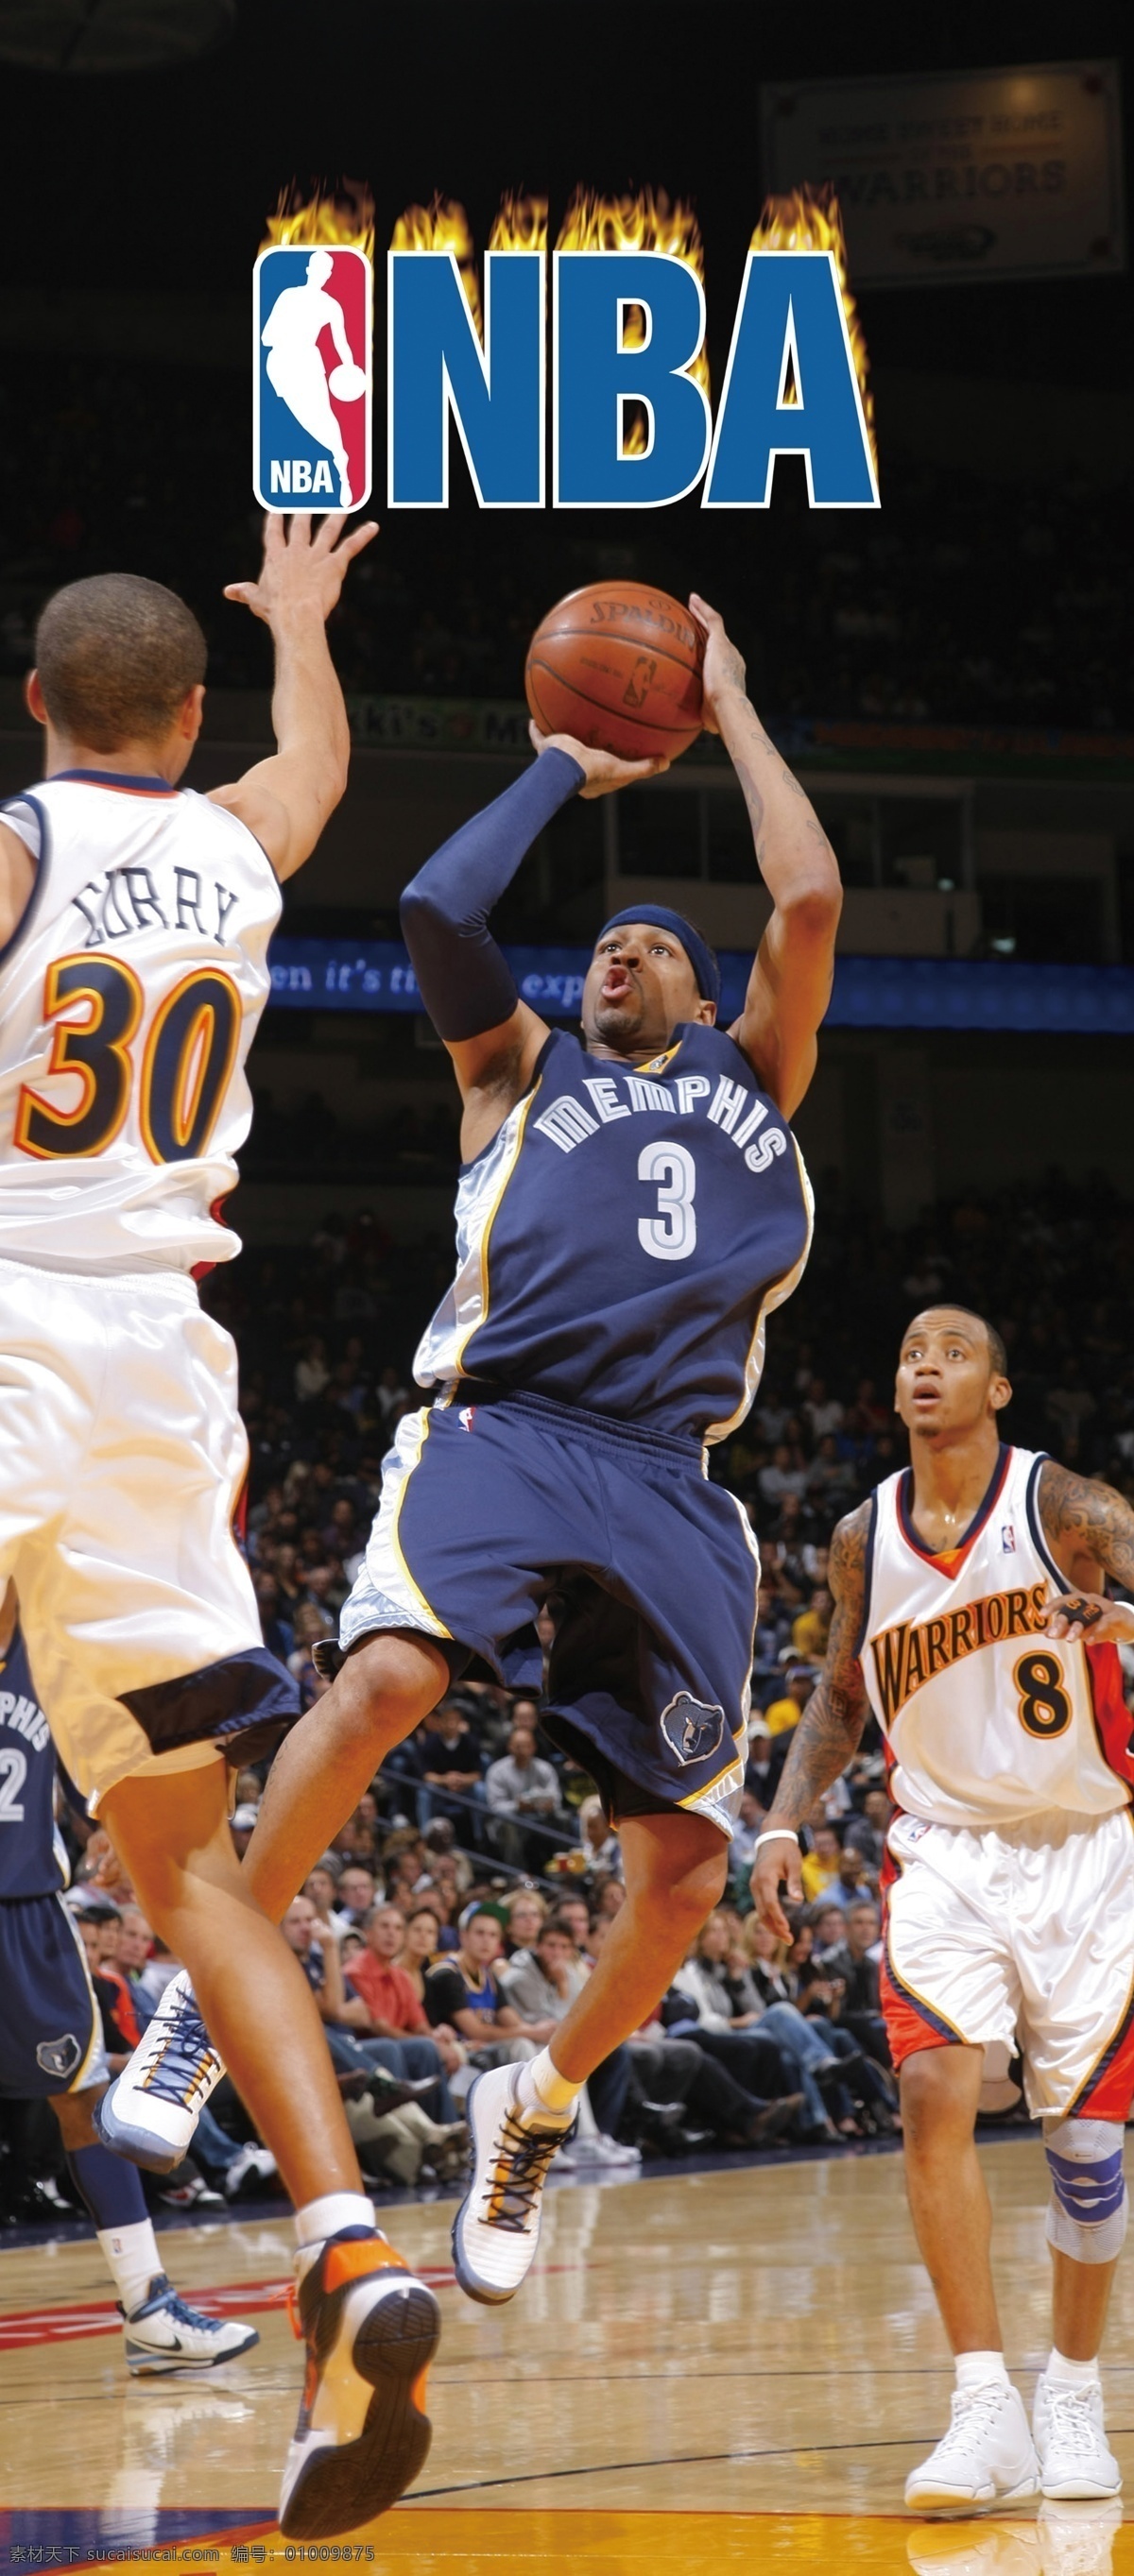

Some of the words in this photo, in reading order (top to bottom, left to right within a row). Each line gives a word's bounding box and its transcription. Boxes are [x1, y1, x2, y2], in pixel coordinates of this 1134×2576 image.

[72, 865, 240, 948] CURRY
[326, 958, 382, 993] it's
[13, 951, 244, 1167] 30
[533, 1073, 788, 1173] MEMPHIS
[637, 1140, 697, 1261] 3
[869, 1578, 1050, 1736] WARRIORS
[1012, 1649, 1074, 1740] 8
[0, 1690, 51, 1753] PHIS
[0, 1748, 27, 1822] 2
